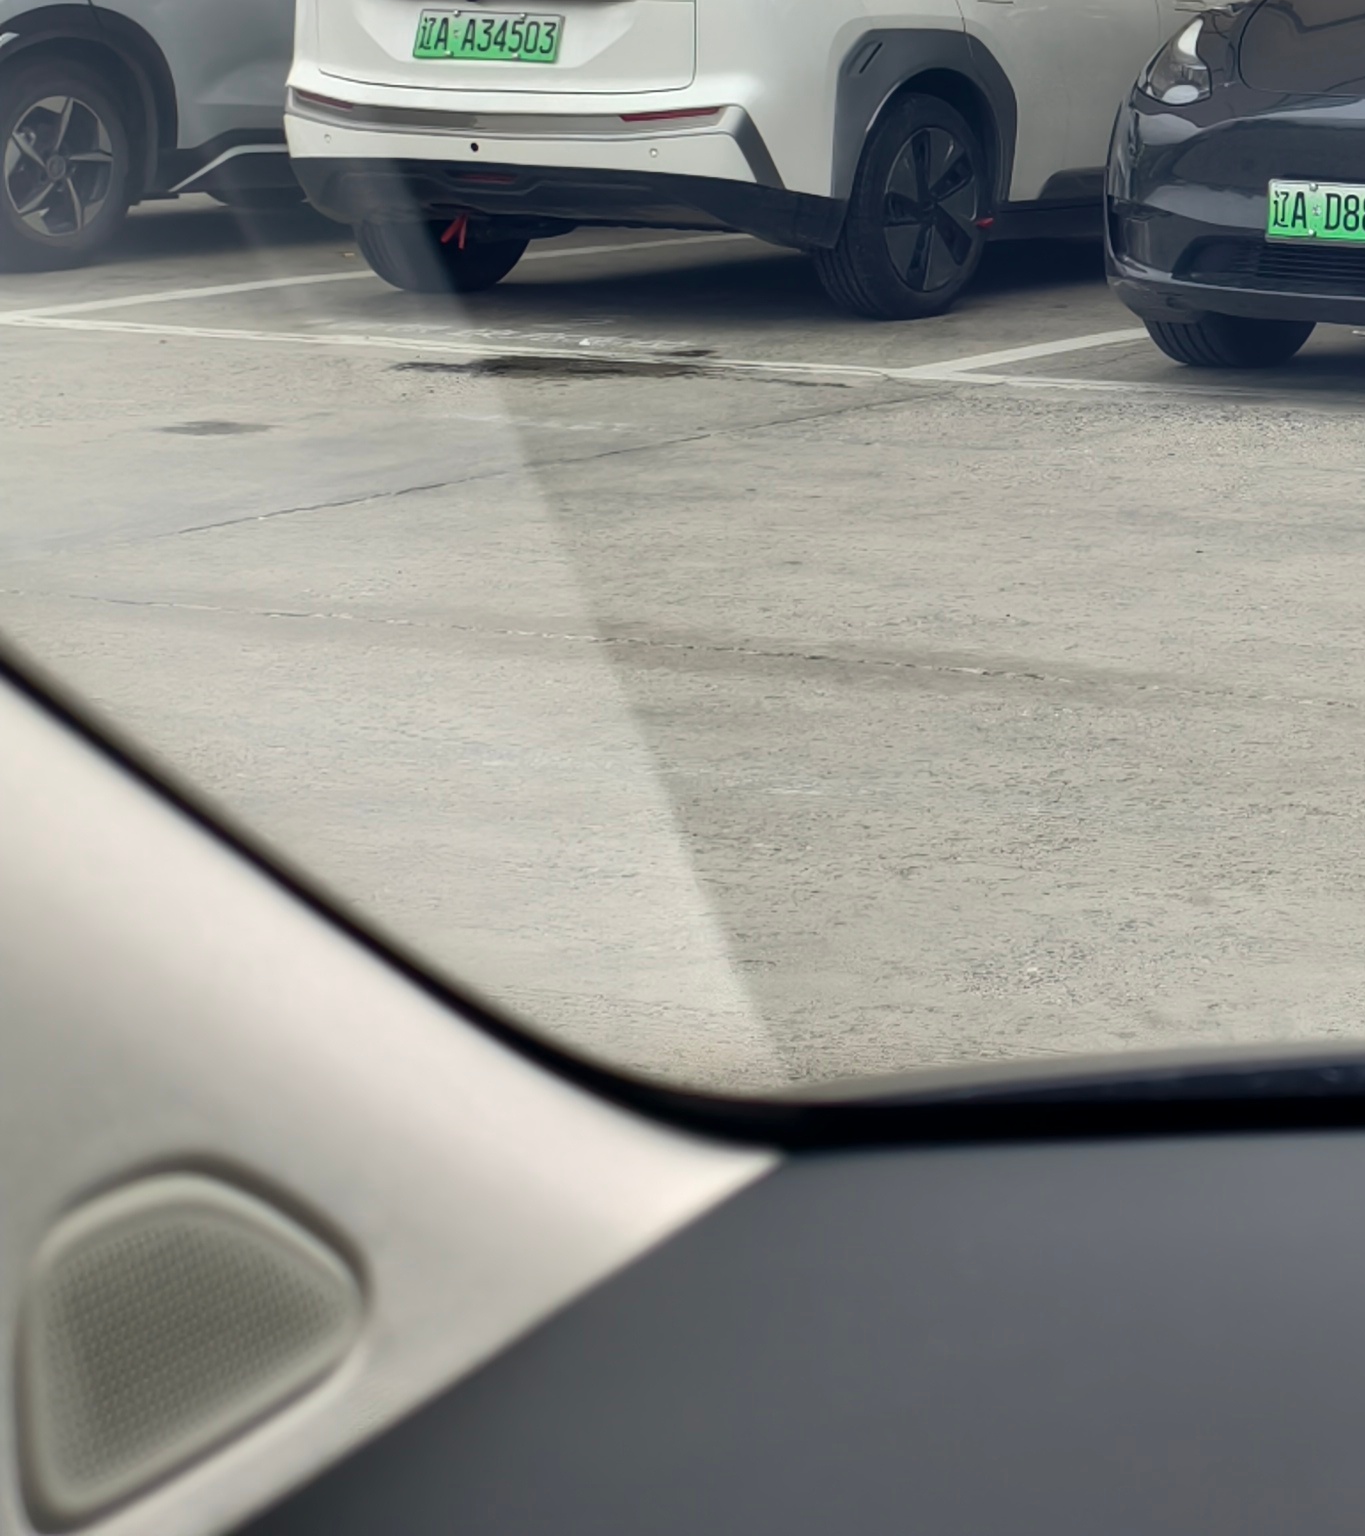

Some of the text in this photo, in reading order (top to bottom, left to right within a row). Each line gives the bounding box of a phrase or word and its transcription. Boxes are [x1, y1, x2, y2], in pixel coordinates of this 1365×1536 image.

[419, 16, 558, 54] 辽A A34503
[1272, 189, 1308, 230] 辽A
